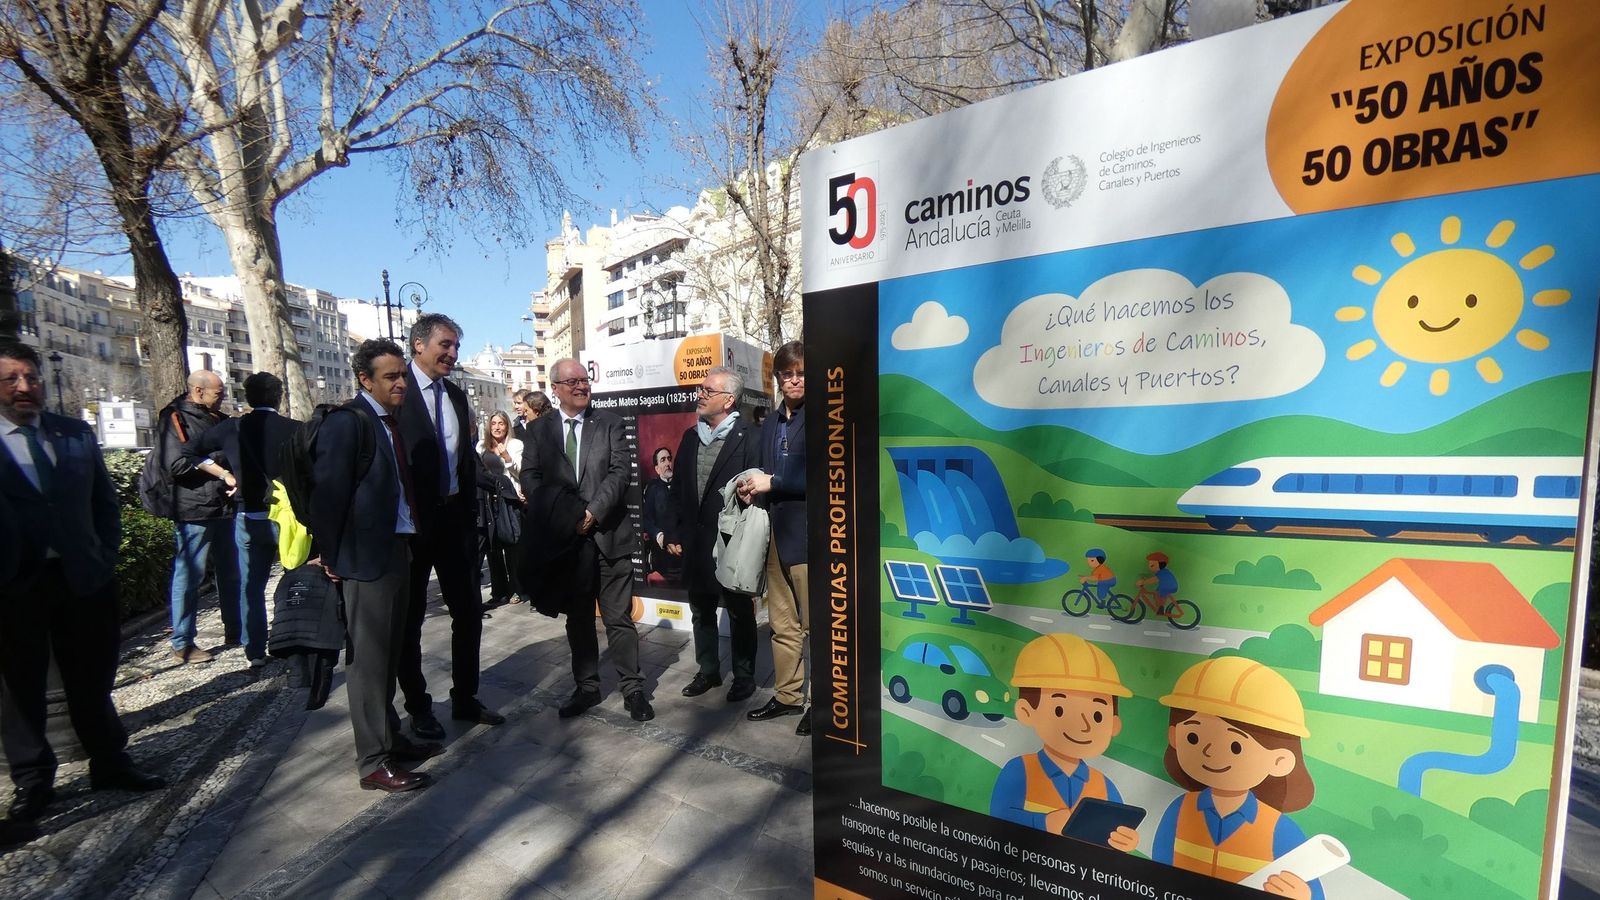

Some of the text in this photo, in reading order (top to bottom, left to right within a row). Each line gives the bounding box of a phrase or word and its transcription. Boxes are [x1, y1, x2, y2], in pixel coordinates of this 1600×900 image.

[1359, 4, 1547, 71] EXPOSICIÓN
[1418, 51, 1544, 113] AÑOS
[1100, 134, 1201, 162] Colegio de Ingenieros
[1099, 159, 1156, 177] de Caminos,
[1099, 168, 1180, 191] Canales y Puertos
[1301, 145, 1352, 186] 50
[828, 172, 877, 249] 50
[905, 176, 1031, 224] caminos
[995, 209, 1021, 222] Ceuta
[905, 214, 991, 250] Andalucía
[996, 218, 1031, 237] y Melilla
[830, 251, 875, 266] ANIVERSARIO
[1045, 289, 1235, 331] ¿Qué hacemos los
[696, 355, 712, 367] AÑOS
[1019, 327, 1266, 368] Ingenieros de Caminos,
[588, 360, 599, 383] 50
[606, 367, 634, 378] caminos
[680, 371, 687, 380] 50
[1038, 364, 1240, 395] Canales y Puertos?
[591, 391, 700, 409] Práxedes Mateo Sagasta (1825-19
[827, 366, 849, 730] COMPETENCIAS PROFESIONALES
[658, 607, 680, 616] guamar
[841, 814, 1085, 900] transporte de mercancías y pasajeros; llevamos
[842, 837, 1001, 900] sequías y a las inundaciones para
[903, 813, 938, 833] posible
[940, 821, 950, 836] la
[952, 829, 1000, 851] conexión
[1004, 841, 1019, 858] de
[1022, 849, 1077, 875] personas
[1080, 866, 1088, 880] y
[1092, 867, 1159, 900] territorios,
[859, 865, 942, 900] somos un servicio
